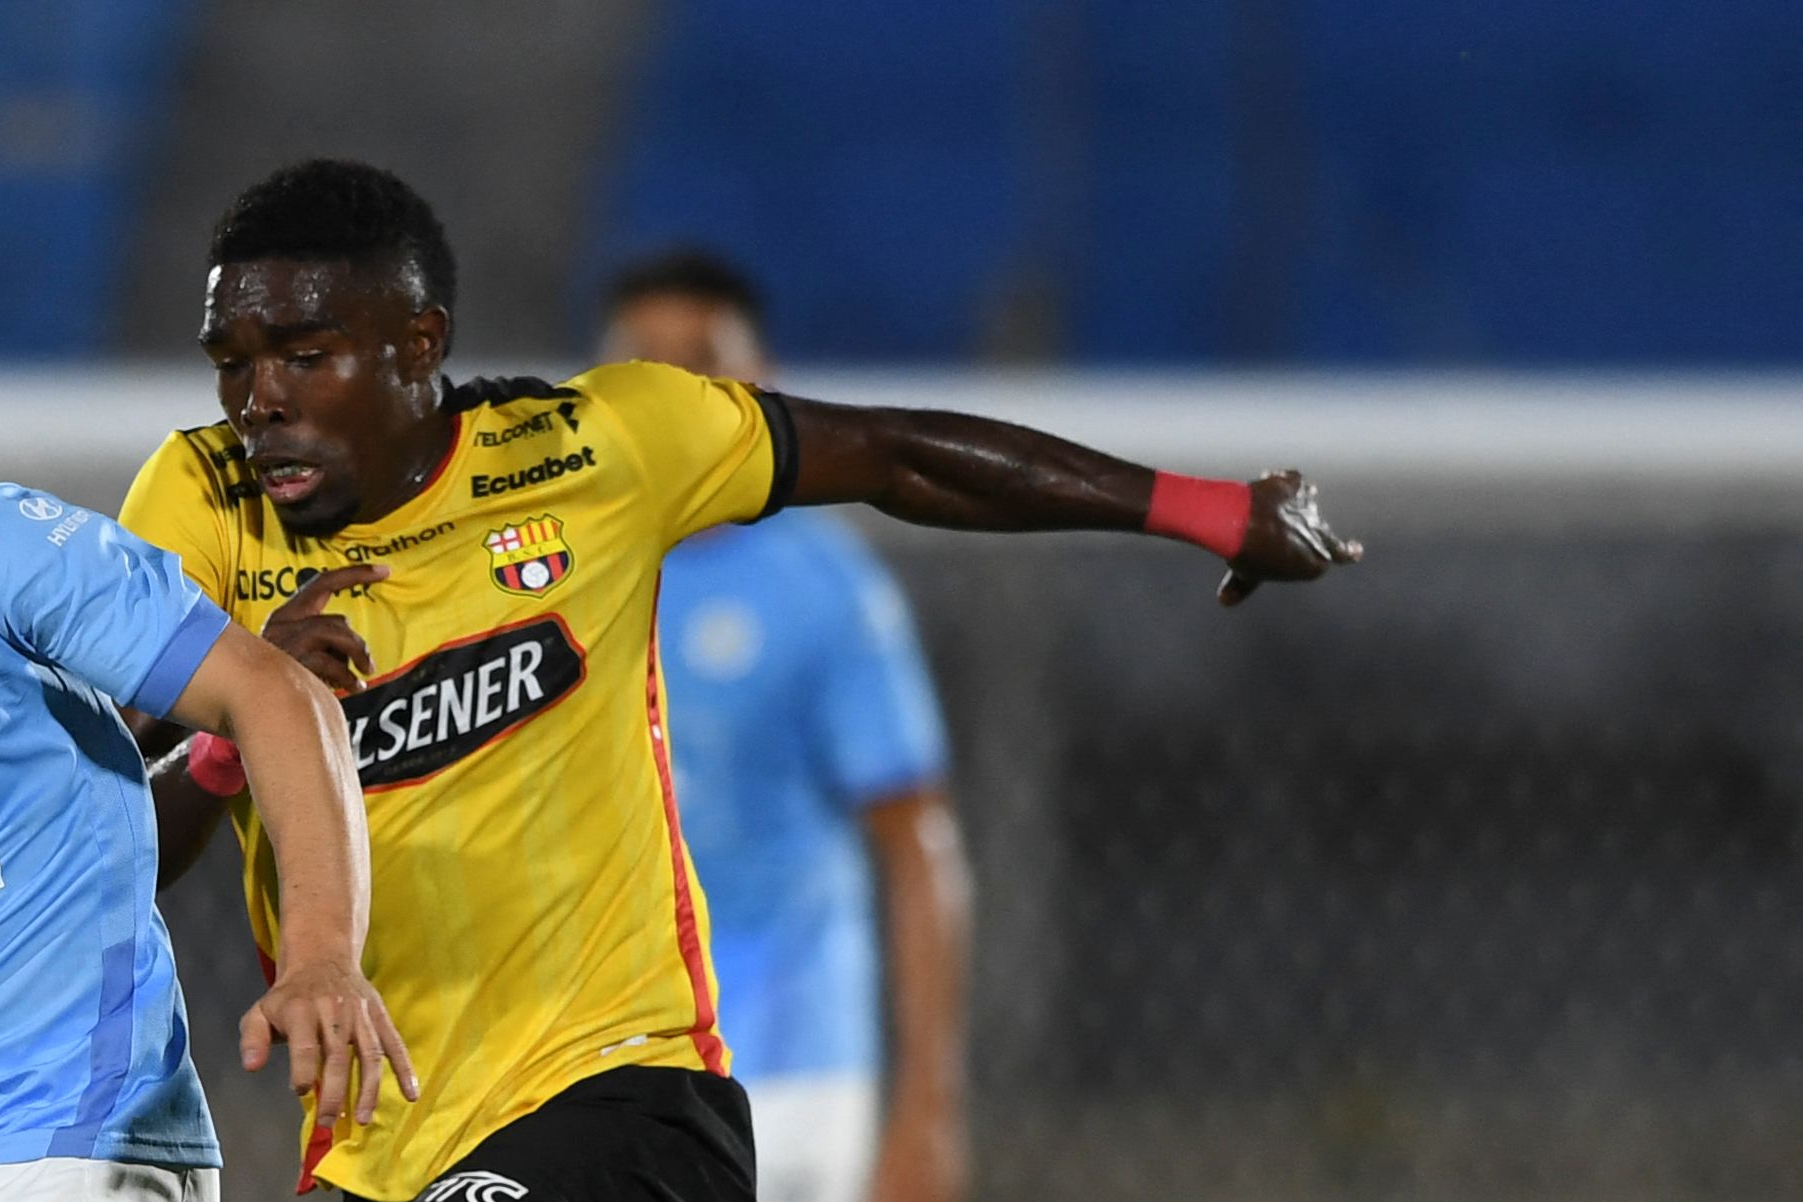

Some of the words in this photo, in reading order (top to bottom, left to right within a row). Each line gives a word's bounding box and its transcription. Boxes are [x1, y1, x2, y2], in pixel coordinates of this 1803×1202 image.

[471, 446, 596, 498] Ecuabet
[344, 520, 456, 564] arathon
[348, 640, 545, 771] LSENER
